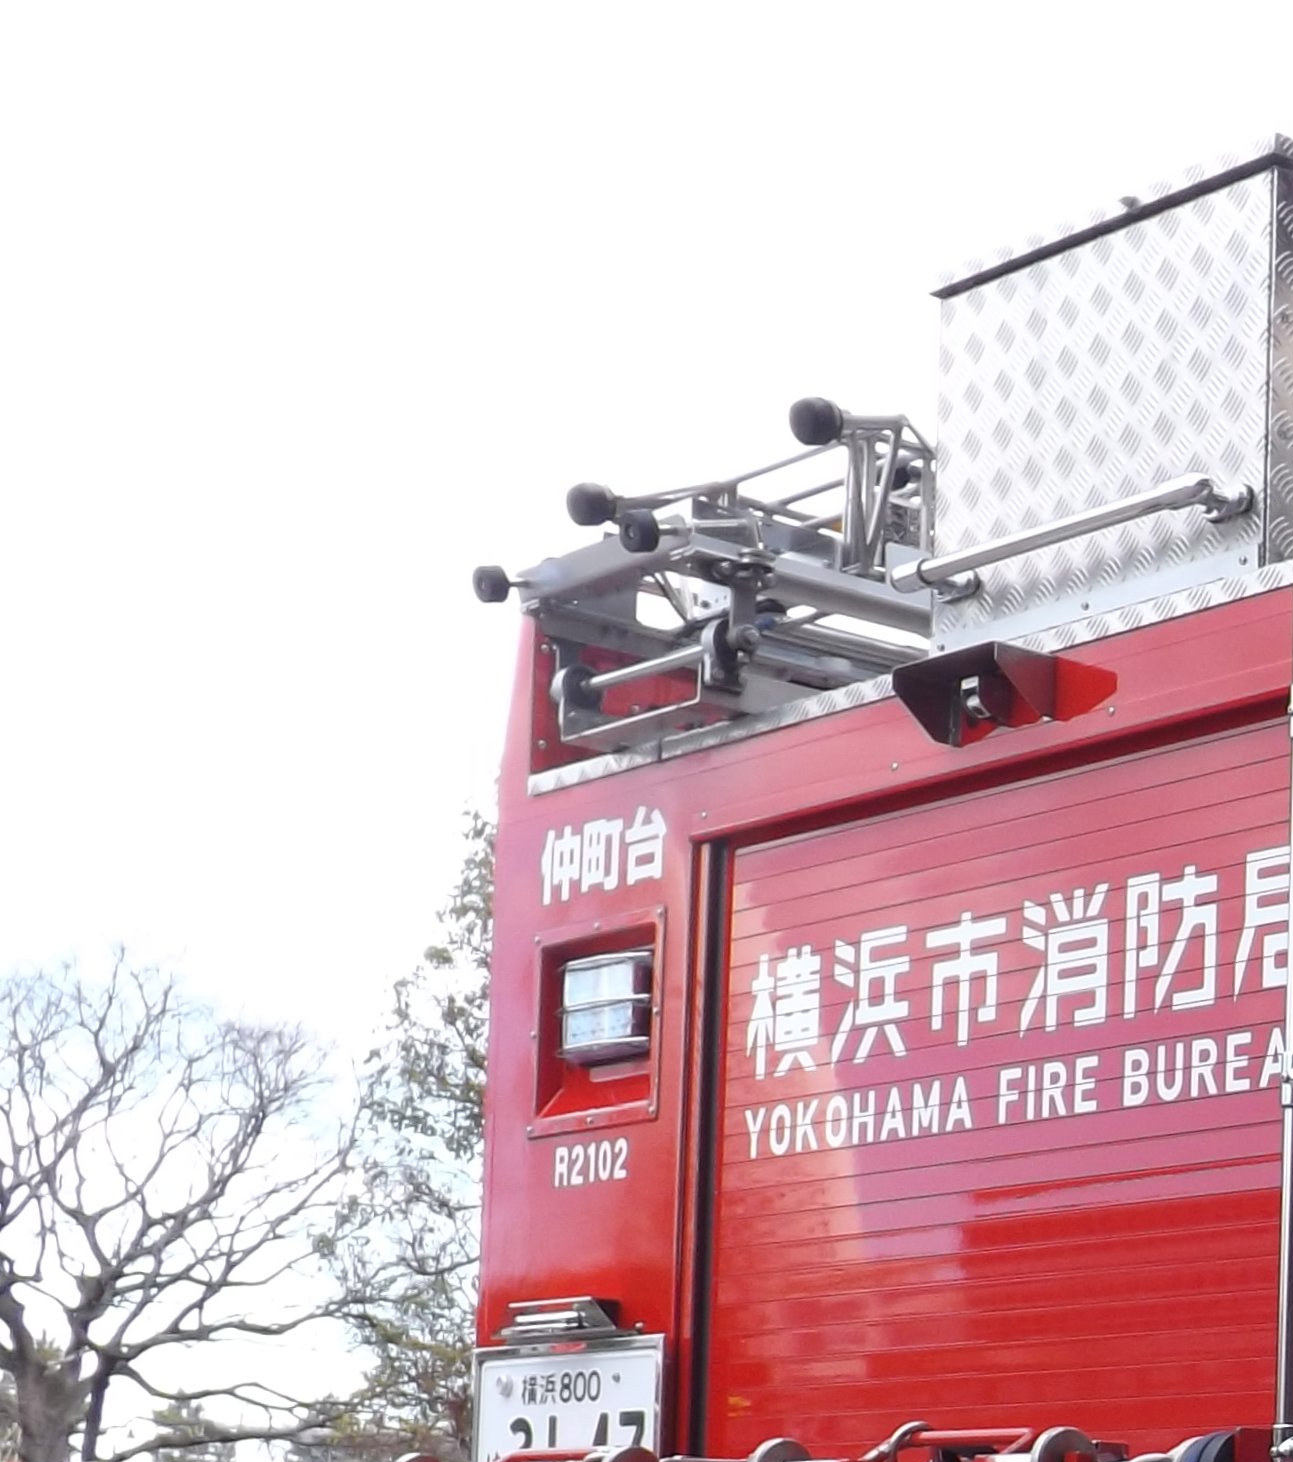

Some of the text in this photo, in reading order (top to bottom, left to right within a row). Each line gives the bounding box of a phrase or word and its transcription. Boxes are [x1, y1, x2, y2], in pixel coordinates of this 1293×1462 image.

[541, 806, 666, 905] 仲町台
[744, 1080, 972, 1159] YOKOHAMA
[998, 1061, 1098, 1124] FIRE
[554, 1138, 629, 1187] R2102
